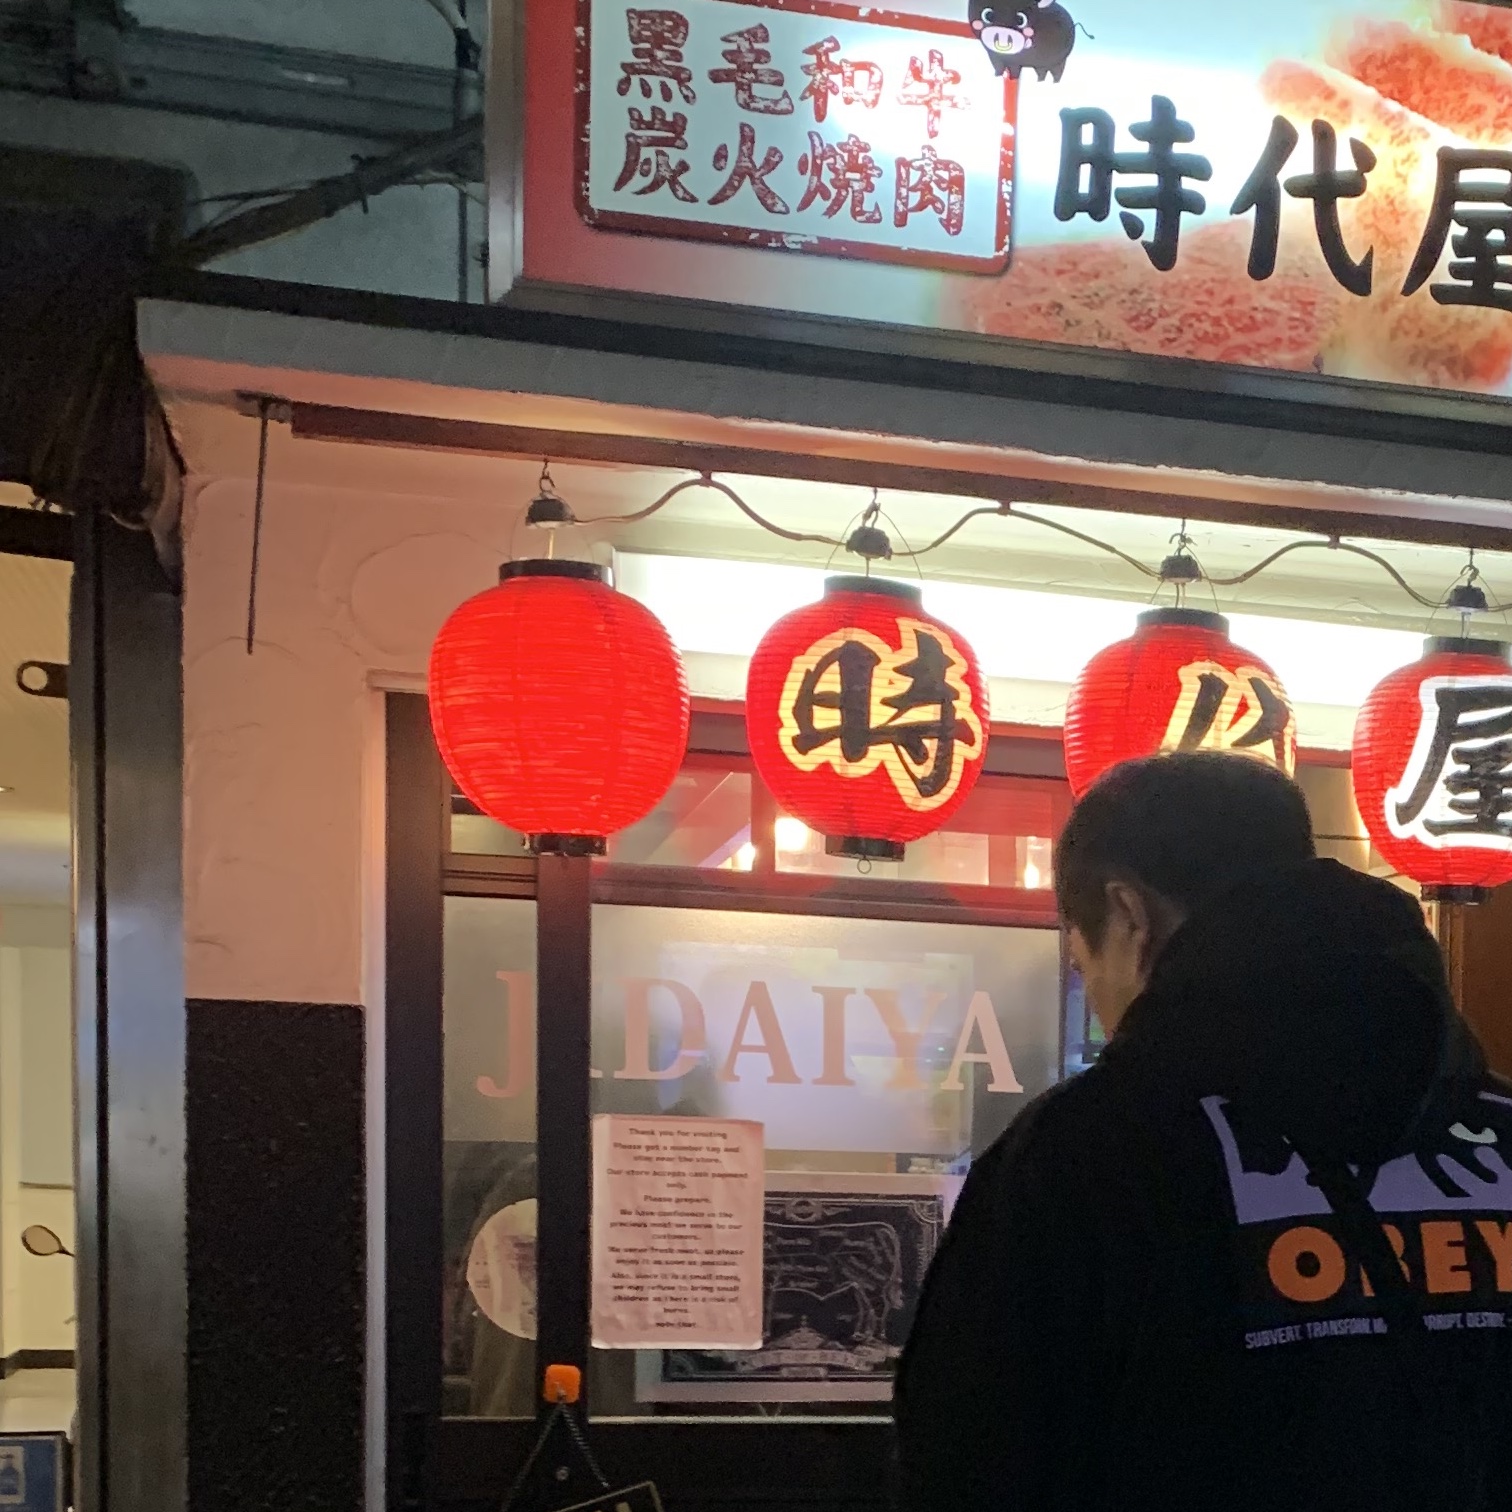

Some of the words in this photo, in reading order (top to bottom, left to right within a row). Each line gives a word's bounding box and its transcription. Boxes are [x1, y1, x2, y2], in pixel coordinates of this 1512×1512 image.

[616, 8, 972, 139] 黒毛和牛
[613, 106, 966, 237] 炭火焼肉
[785, 622, 981, 805] 時
[476, 969, 1024, 1094] JDAIYA
